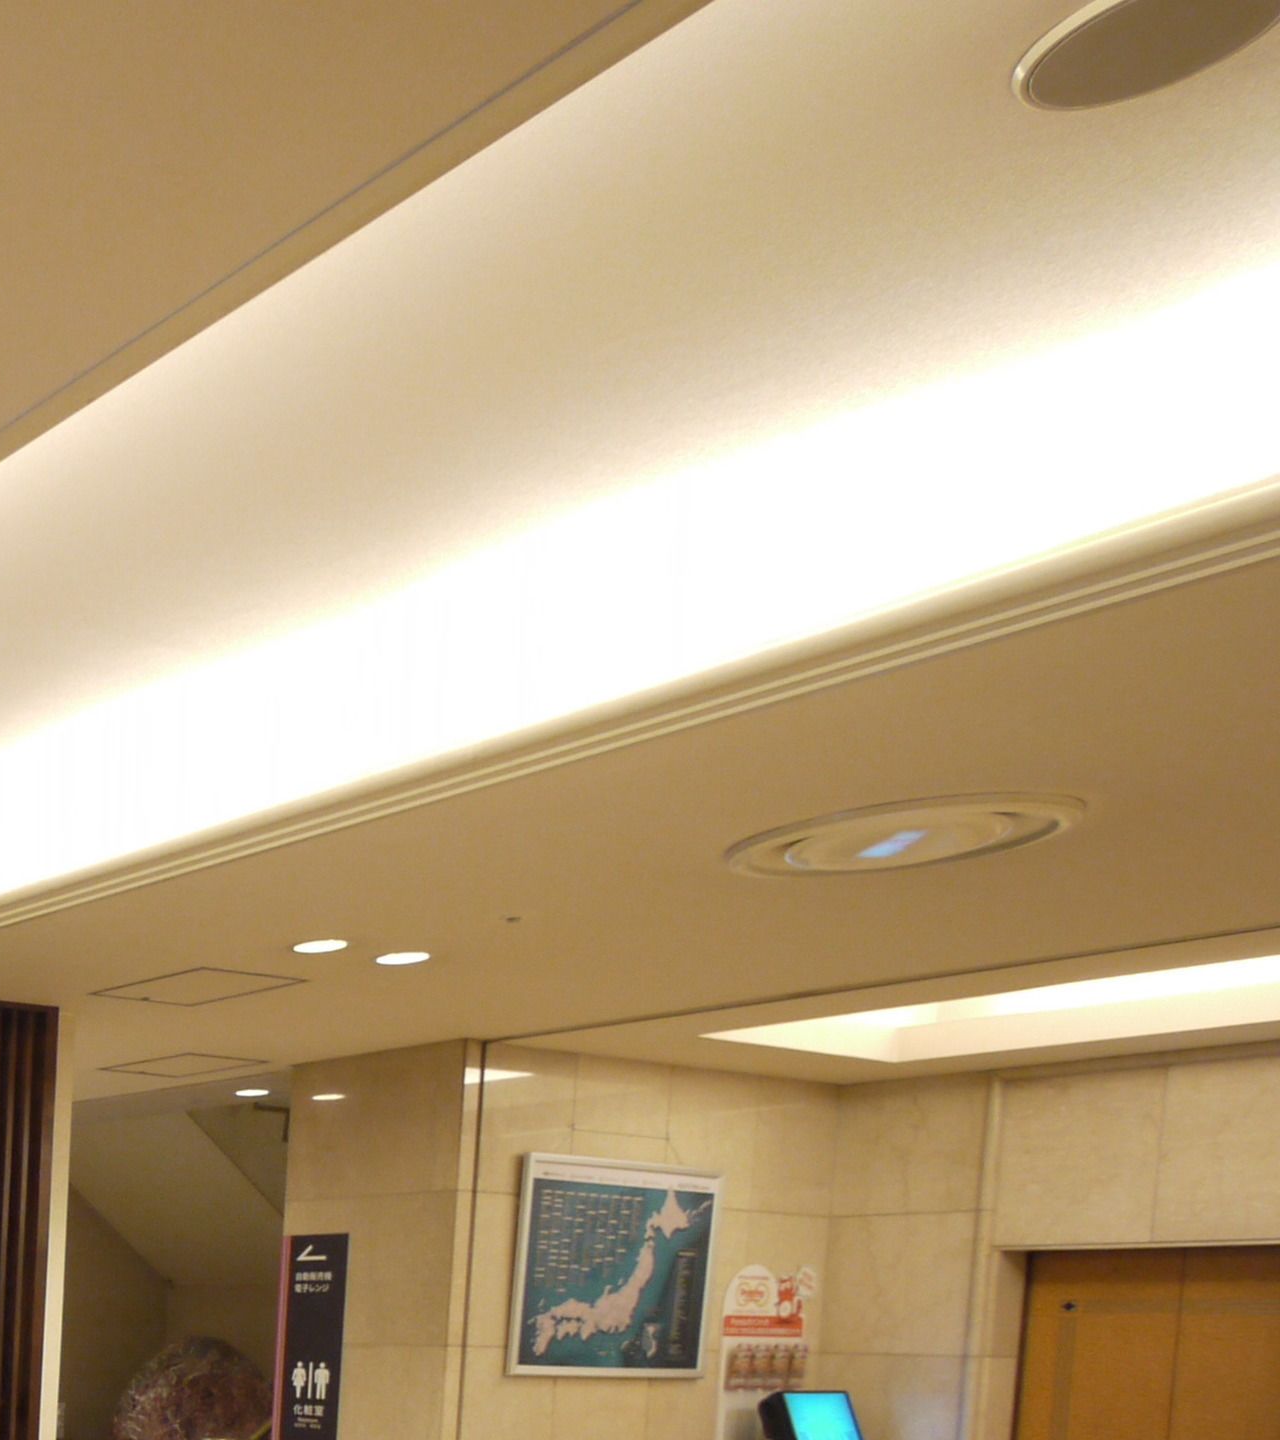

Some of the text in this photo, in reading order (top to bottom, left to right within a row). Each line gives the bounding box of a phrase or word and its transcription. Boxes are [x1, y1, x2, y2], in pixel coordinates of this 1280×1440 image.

[294, 1283, 330, 1293] 電子レンジ
[293, 1404, 325, 1417] 化粧室
